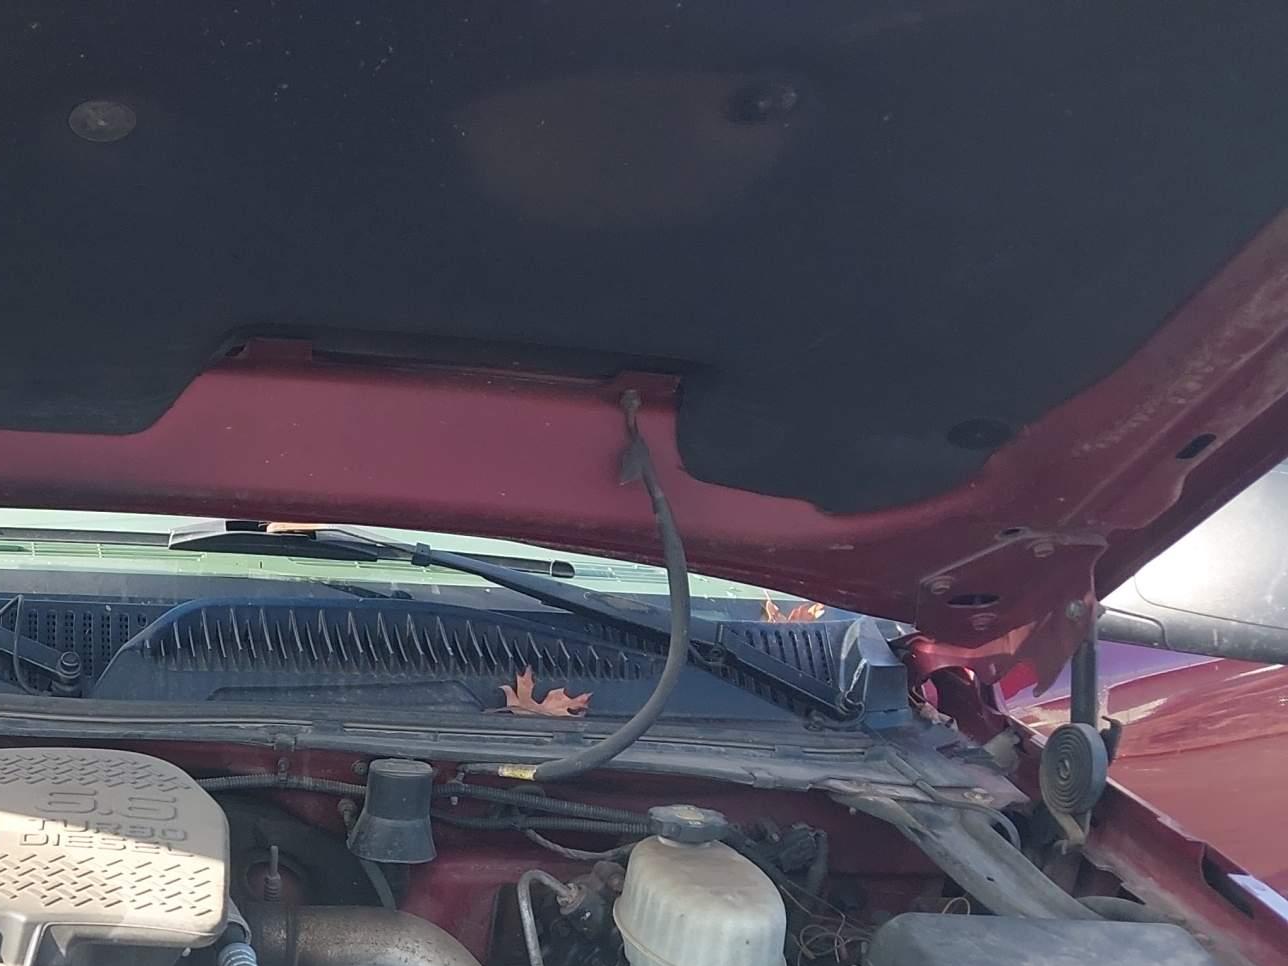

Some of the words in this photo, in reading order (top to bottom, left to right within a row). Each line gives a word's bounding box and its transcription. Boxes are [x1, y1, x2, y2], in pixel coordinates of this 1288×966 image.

[35, 788, 179, 822] 6.6
[29, 818, 189, 842] TURBO
[19, 832, 195, 858] DIESEL
